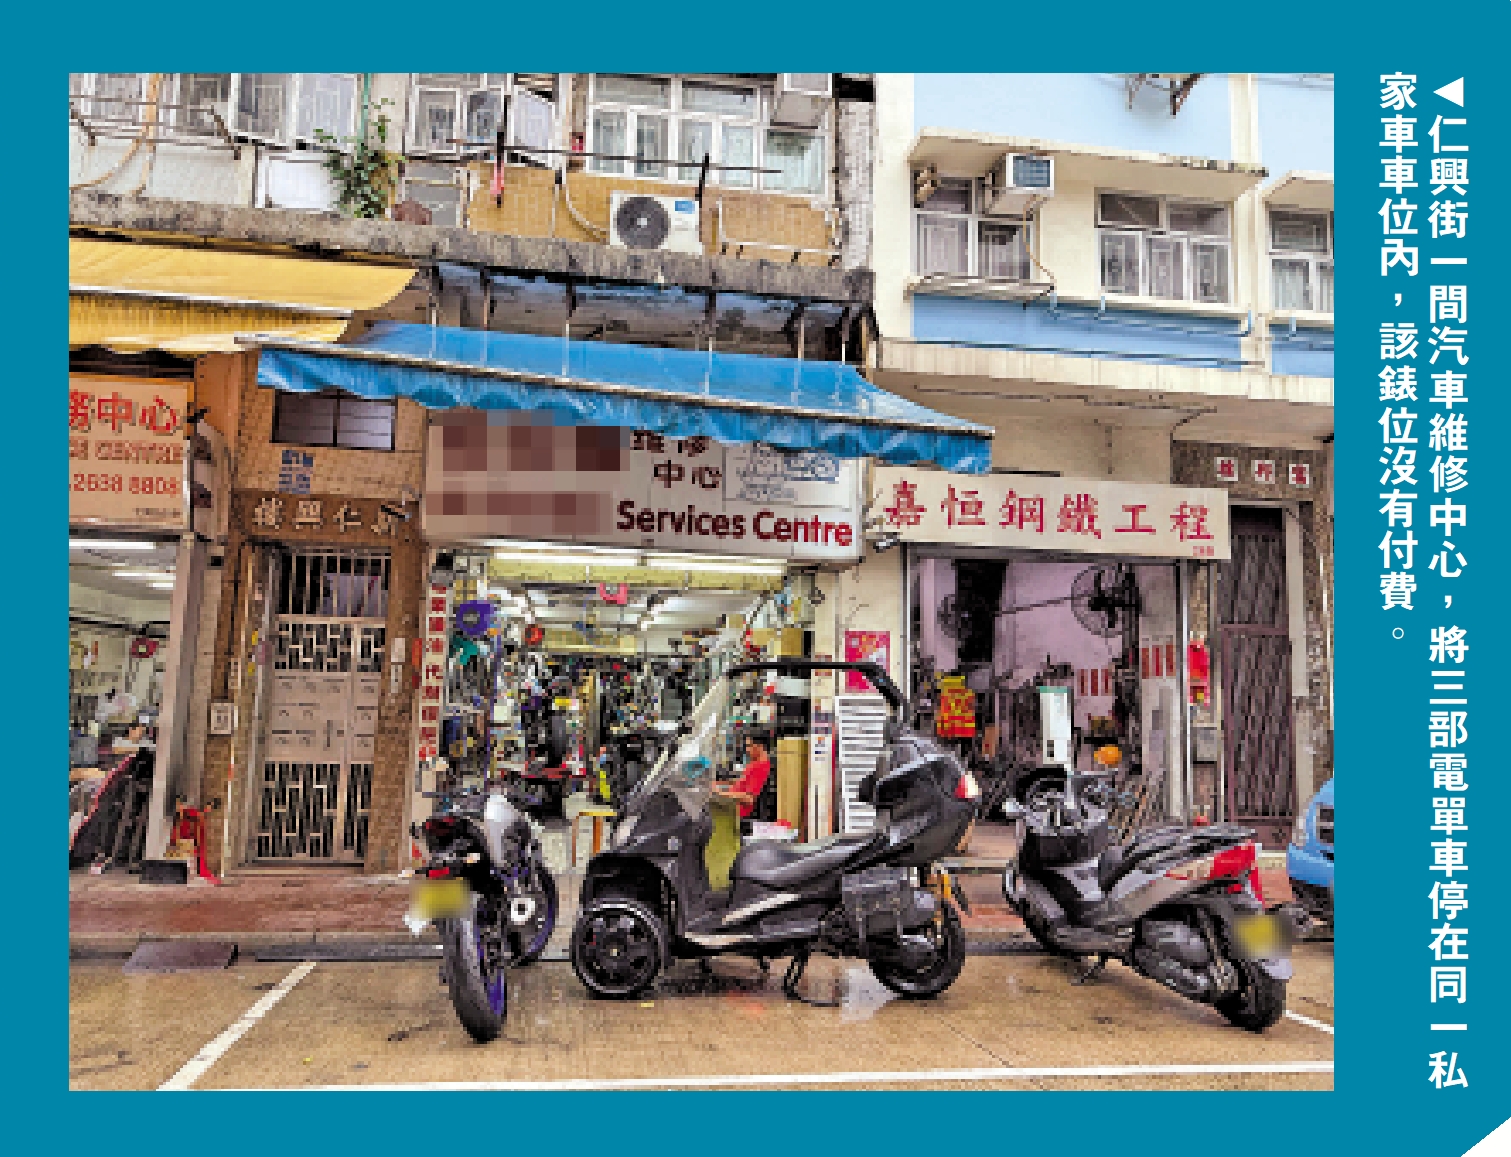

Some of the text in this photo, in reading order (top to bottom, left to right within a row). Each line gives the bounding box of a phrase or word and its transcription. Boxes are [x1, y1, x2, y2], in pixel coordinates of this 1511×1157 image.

[654, 459, 723, 490] 中心
[616, 500, 853, 546] Services Centre
